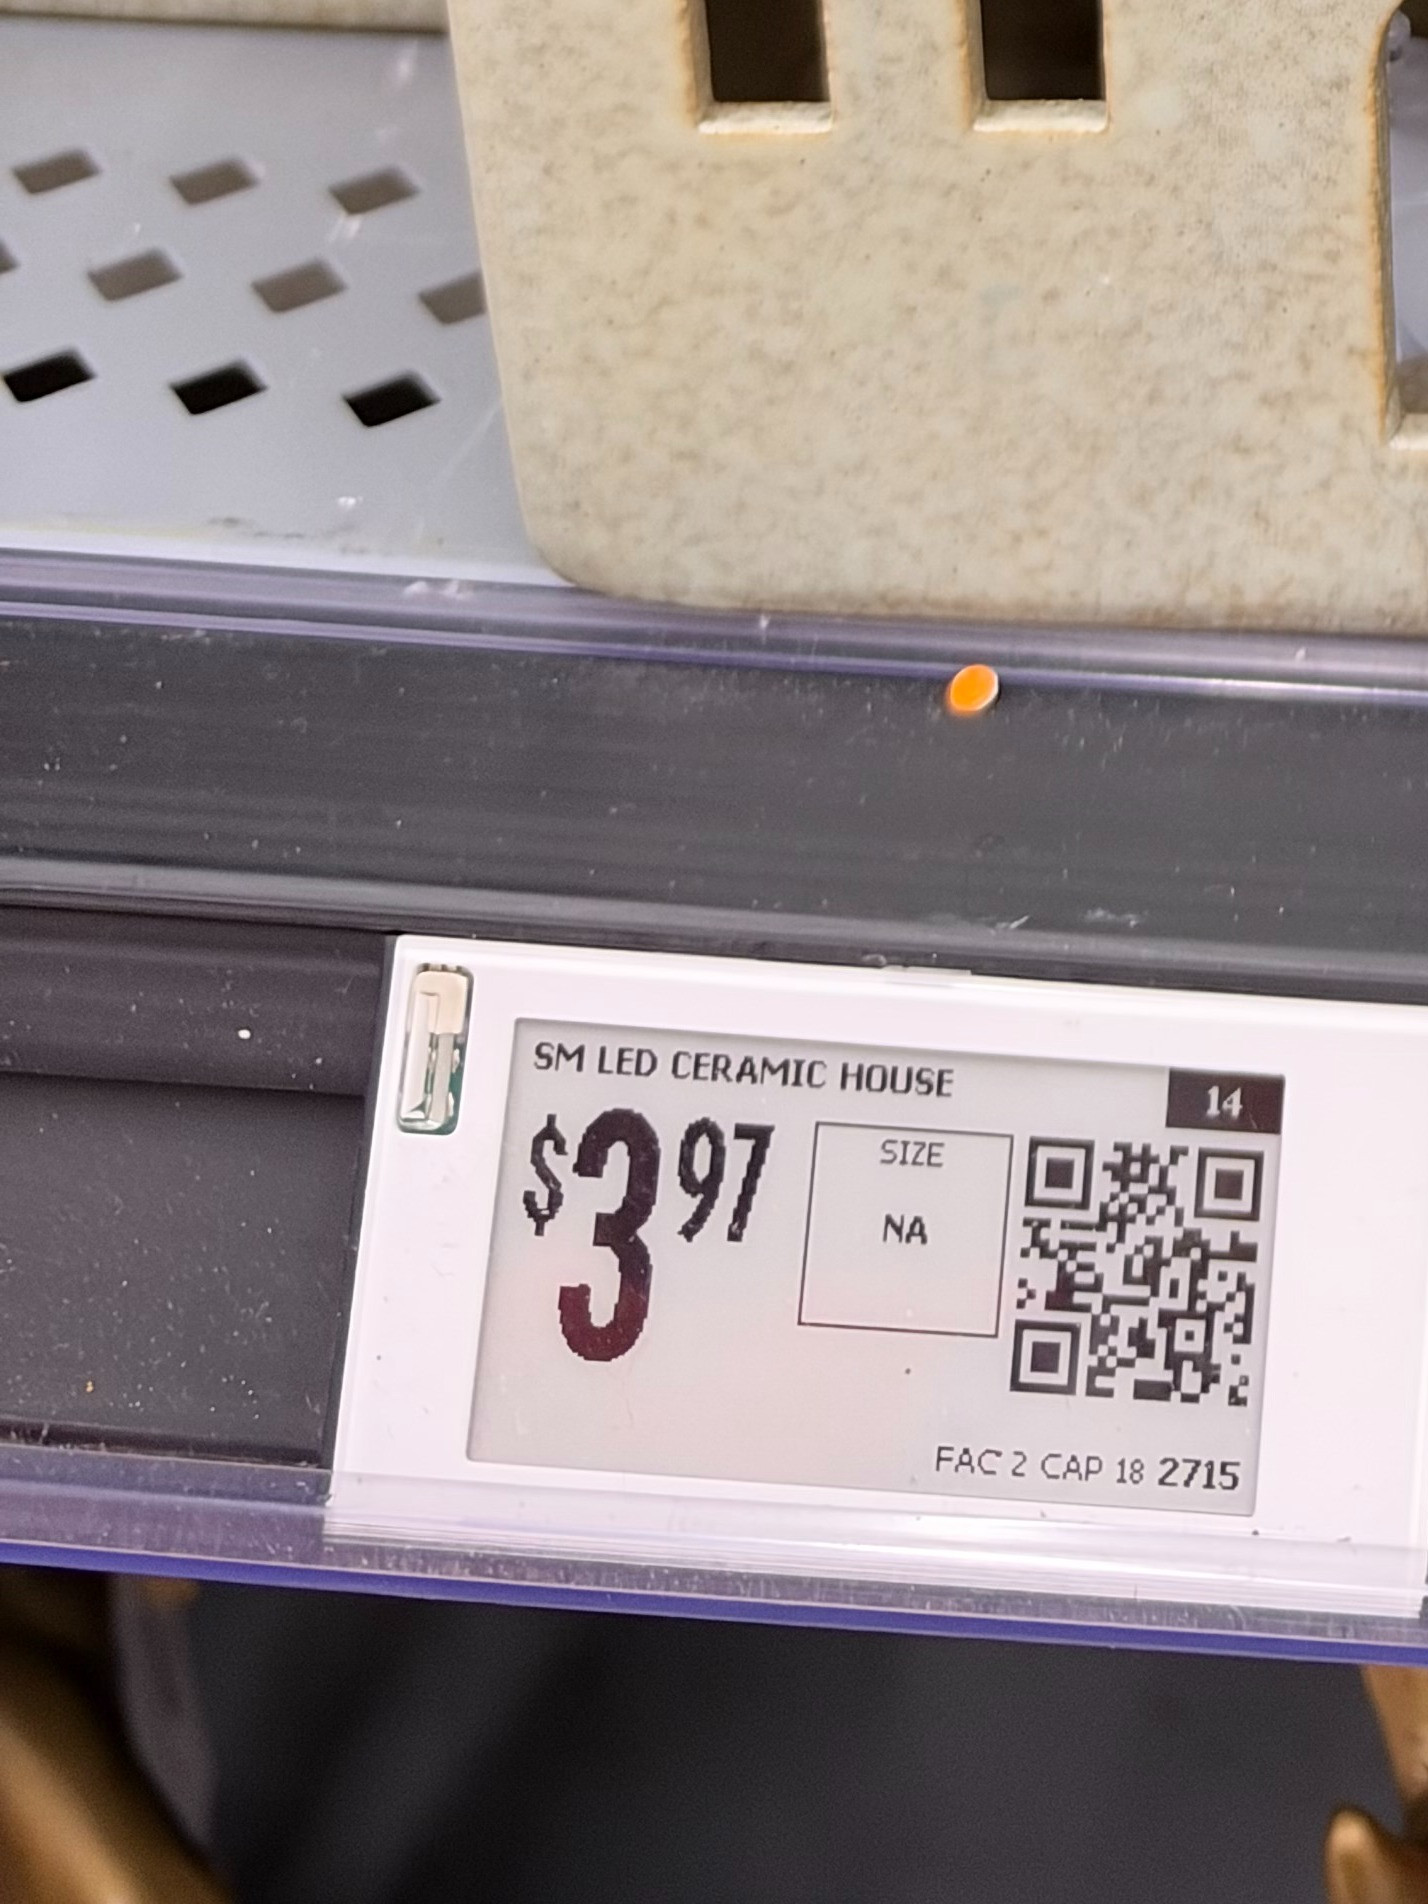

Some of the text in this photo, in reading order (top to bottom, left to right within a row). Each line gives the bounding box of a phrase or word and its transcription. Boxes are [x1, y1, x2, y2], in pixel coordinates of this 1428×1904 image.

[534, 1042, 953, 1097] SM LED CERAMIC HOUSE
[1206, 1085, 1243, 1119] 14
[880, 1139, 945, 1168] SIZE
[883, 1214, 928, 1245] NA
[935, 1445, 1240, 1491] FAC 2 CAP 18 2715
